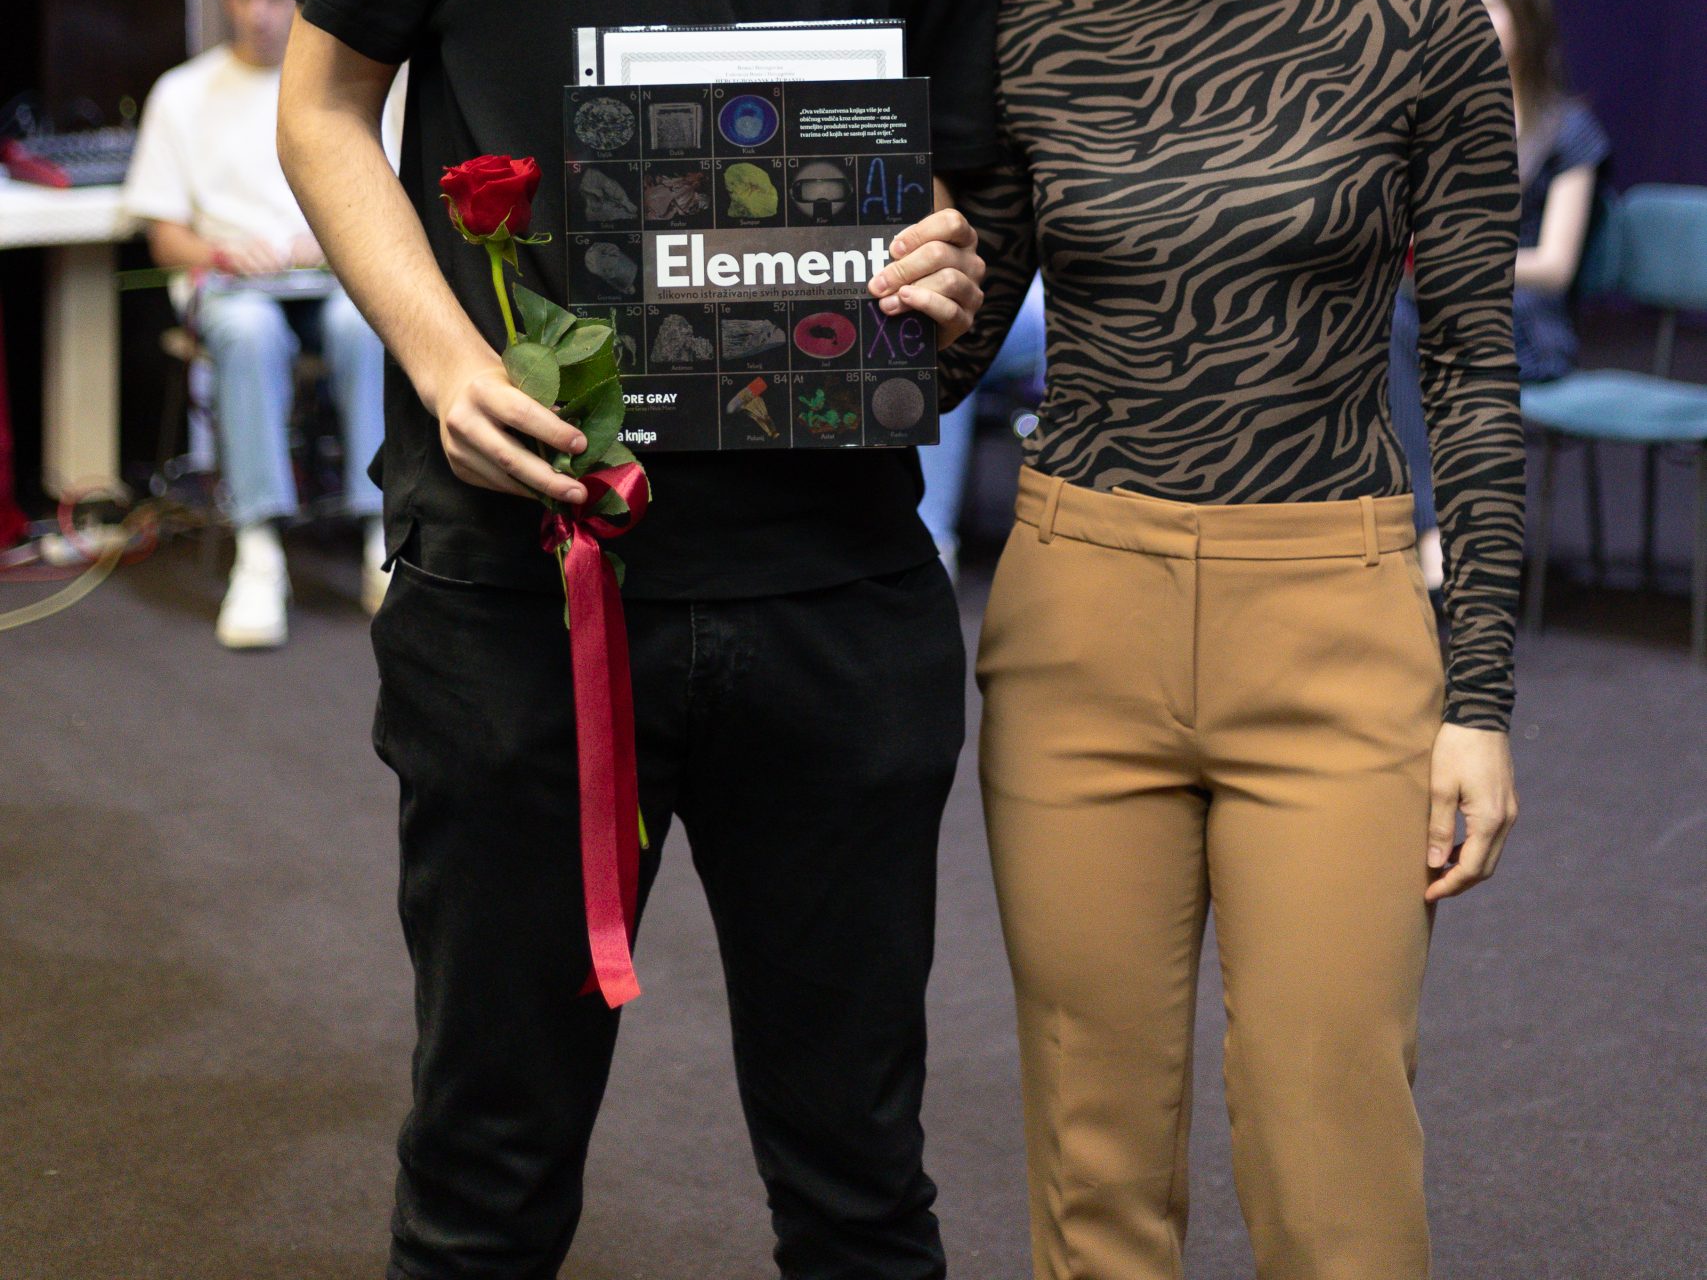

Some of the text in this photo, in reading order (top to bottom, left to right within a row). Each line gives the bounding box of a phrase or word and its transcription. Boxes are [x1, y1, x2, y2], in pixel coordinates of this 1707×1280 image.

[571, 92, 579, 102] C
[630, 91, 637, 100] 6
[643, 90, 651, 100] N
[702, 89, 709, 98] 7
[714, 88, 724, 98] O
[772, 87, 781, 97] 8
[699, 160, 711, 170] 15
[715, 160, 722, 169] S
[771, 159, 782, 169] 16
[788, 157, 799, 168] Cl
[844, 157, 854, 167] 17
[915, 156, 927, 165] 18
[573, 163, 581, 174] Si
[628, 162, 639, 173] 14
[644, 161, 652, 171] P
[862, 157, 925, 215] Ar
[575, 234, 590, 245] Ge
[627, 233, 641, 244] 32
[656, 233, 890, 288] Element
[658, 291, 699, 300] slikovno
[700, 289, 758, 299] istraživanje
[759, 289, 779, 297] svih
[781, 288, 825, 298] poznatih
[827, 288, 858, 296] atoma
[648, 305, 660, 316] Sb
[704, 303, 714, 314] 51
[720, 304, 731, 314] Te
[773, 302, 786, 311] 52
[844, 301, 857, 310] 53
[576, 307, 588, 317] Sn
[626, 306, 642, 316] 50
[867, 301, 926, 359] Xe
[773, 374, 788, 384] 84
[793, 375, 804, 384] At
[846, 373, 860, 383] 85
[864, 373, 877, 382] Rn
[917, 371, 931, 380] 86
[721, 376, 733, 386] Po
[646, 393, 678, 404] GRAY
[625, 429, 657, 444] knjiga
